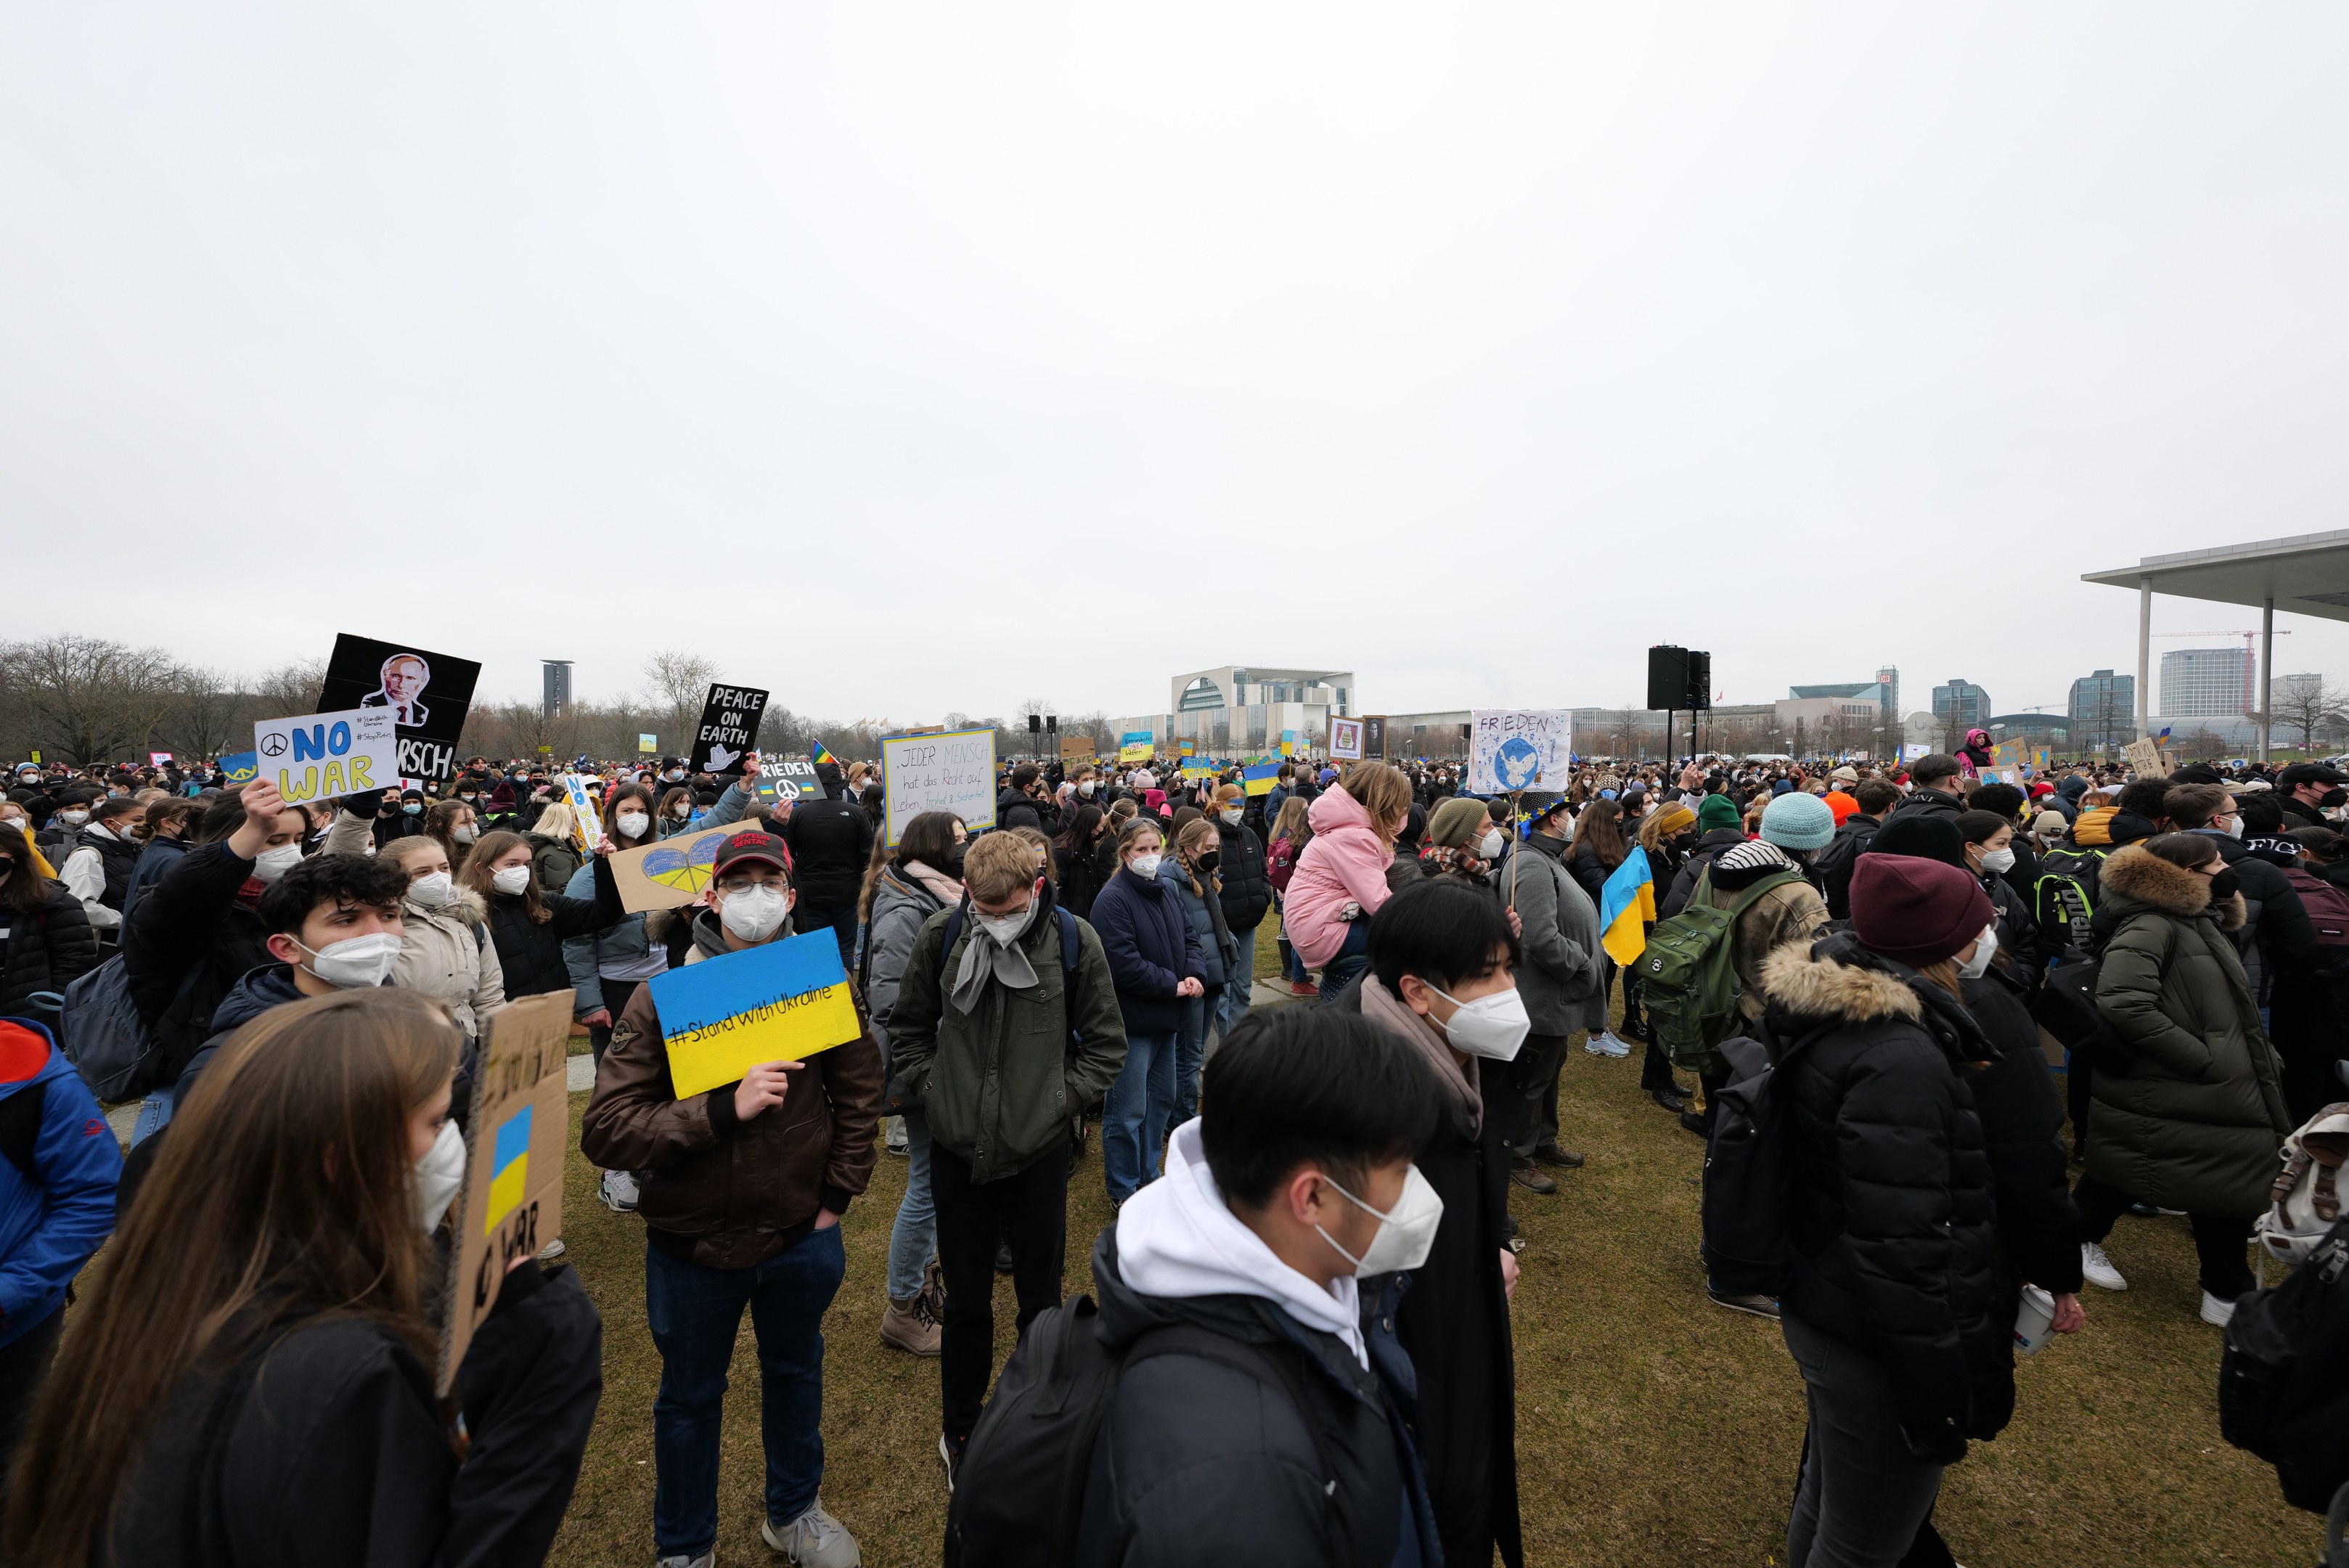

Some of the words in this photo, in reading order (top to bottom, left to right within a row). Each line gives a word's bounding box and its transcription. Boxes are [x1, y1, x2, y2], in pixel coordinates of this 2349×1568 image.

[711, 687, 763, 710] PEACE
[721, 711, 742, 726] ON
[293, 721, 351, 762] NO
[356, 731, 393, 742] #StopPutin
[700, 725, 748, 745] EARTH
[395, 738, 453, 780] RSCH
[944, 743, 989, 765] MENSCH
[1187, 758, 1206, 767] STOP
[279, 755, 375, 803] WAR
[756, 762, 815, 778] RIEDEN
[903, 775, 919, 790] hat
[923, 774, 937, 787] das
[941, 768, 964, 785] Recht
[967, 767, 984, 787] auf
[1188, 768, 1209, 777] WAR!
[893, 794, 922, 812] Leben,
[949, 794, 954, 804] &
[956, 787, 986, 803] Sicherheit
[567, 777, 585, 805] NO
[577, 804, 599, 848] WAR
[732, 833, 772, 846] ZEPPELIN
[734, 838, 768, 849] RENTAL
[773, 984, 833, 1015] Ukraine
